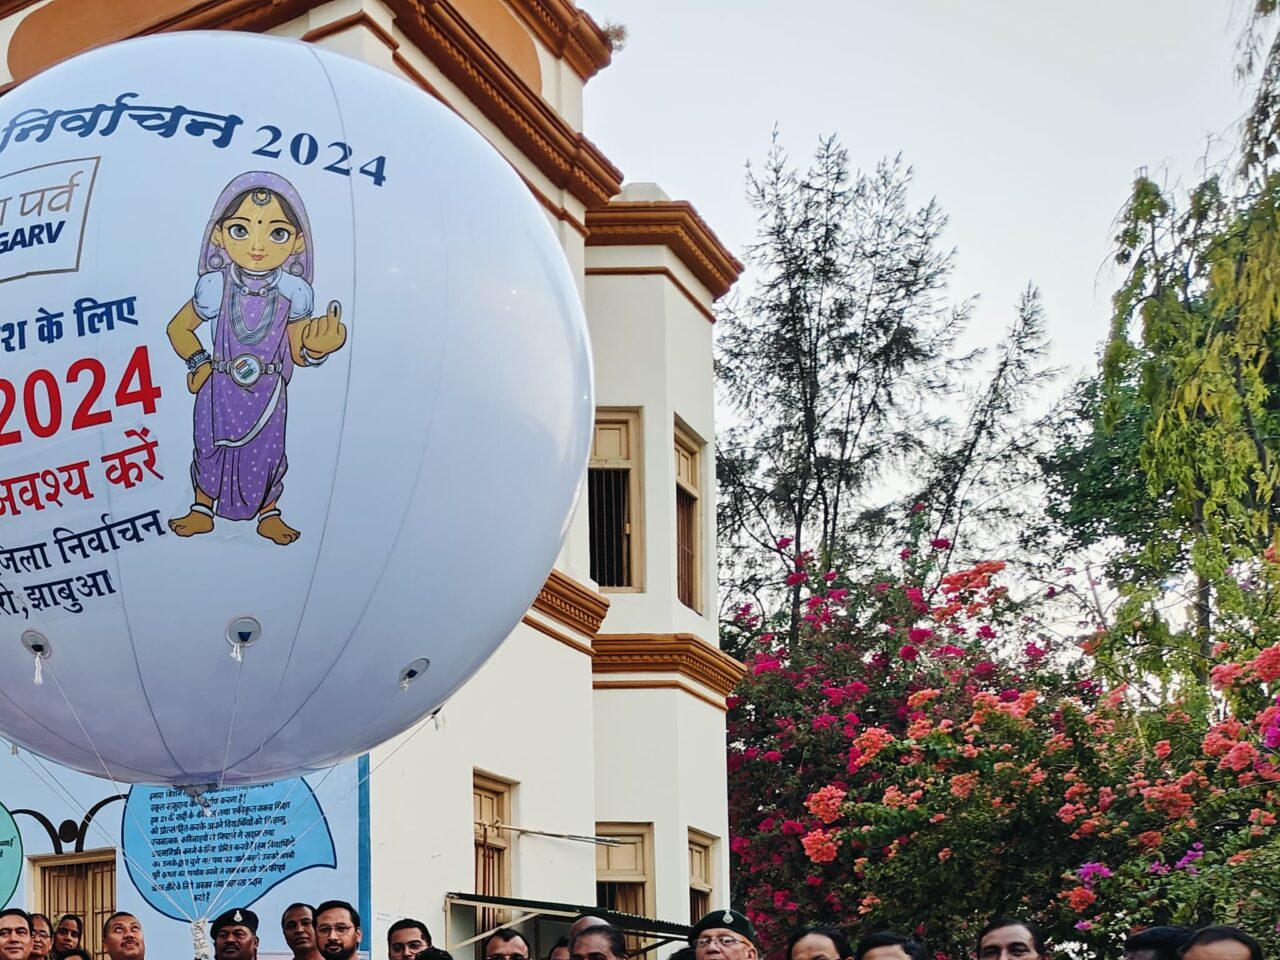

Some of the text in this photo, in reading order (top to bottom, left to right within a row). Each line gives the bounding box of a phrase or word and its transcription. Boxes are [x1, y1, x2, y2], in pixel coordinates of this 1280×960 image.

[250, 124, 389, 188] 2024
[18, 170, 83, 218] पर्व
[35, 306, 64, 345] के
[74, 296, 140, 335] लिए
[101, 426, 165, 490] करें
[53, 508, 167, 569] निर्वाचन
[217, 808, 230, 817] तथा
